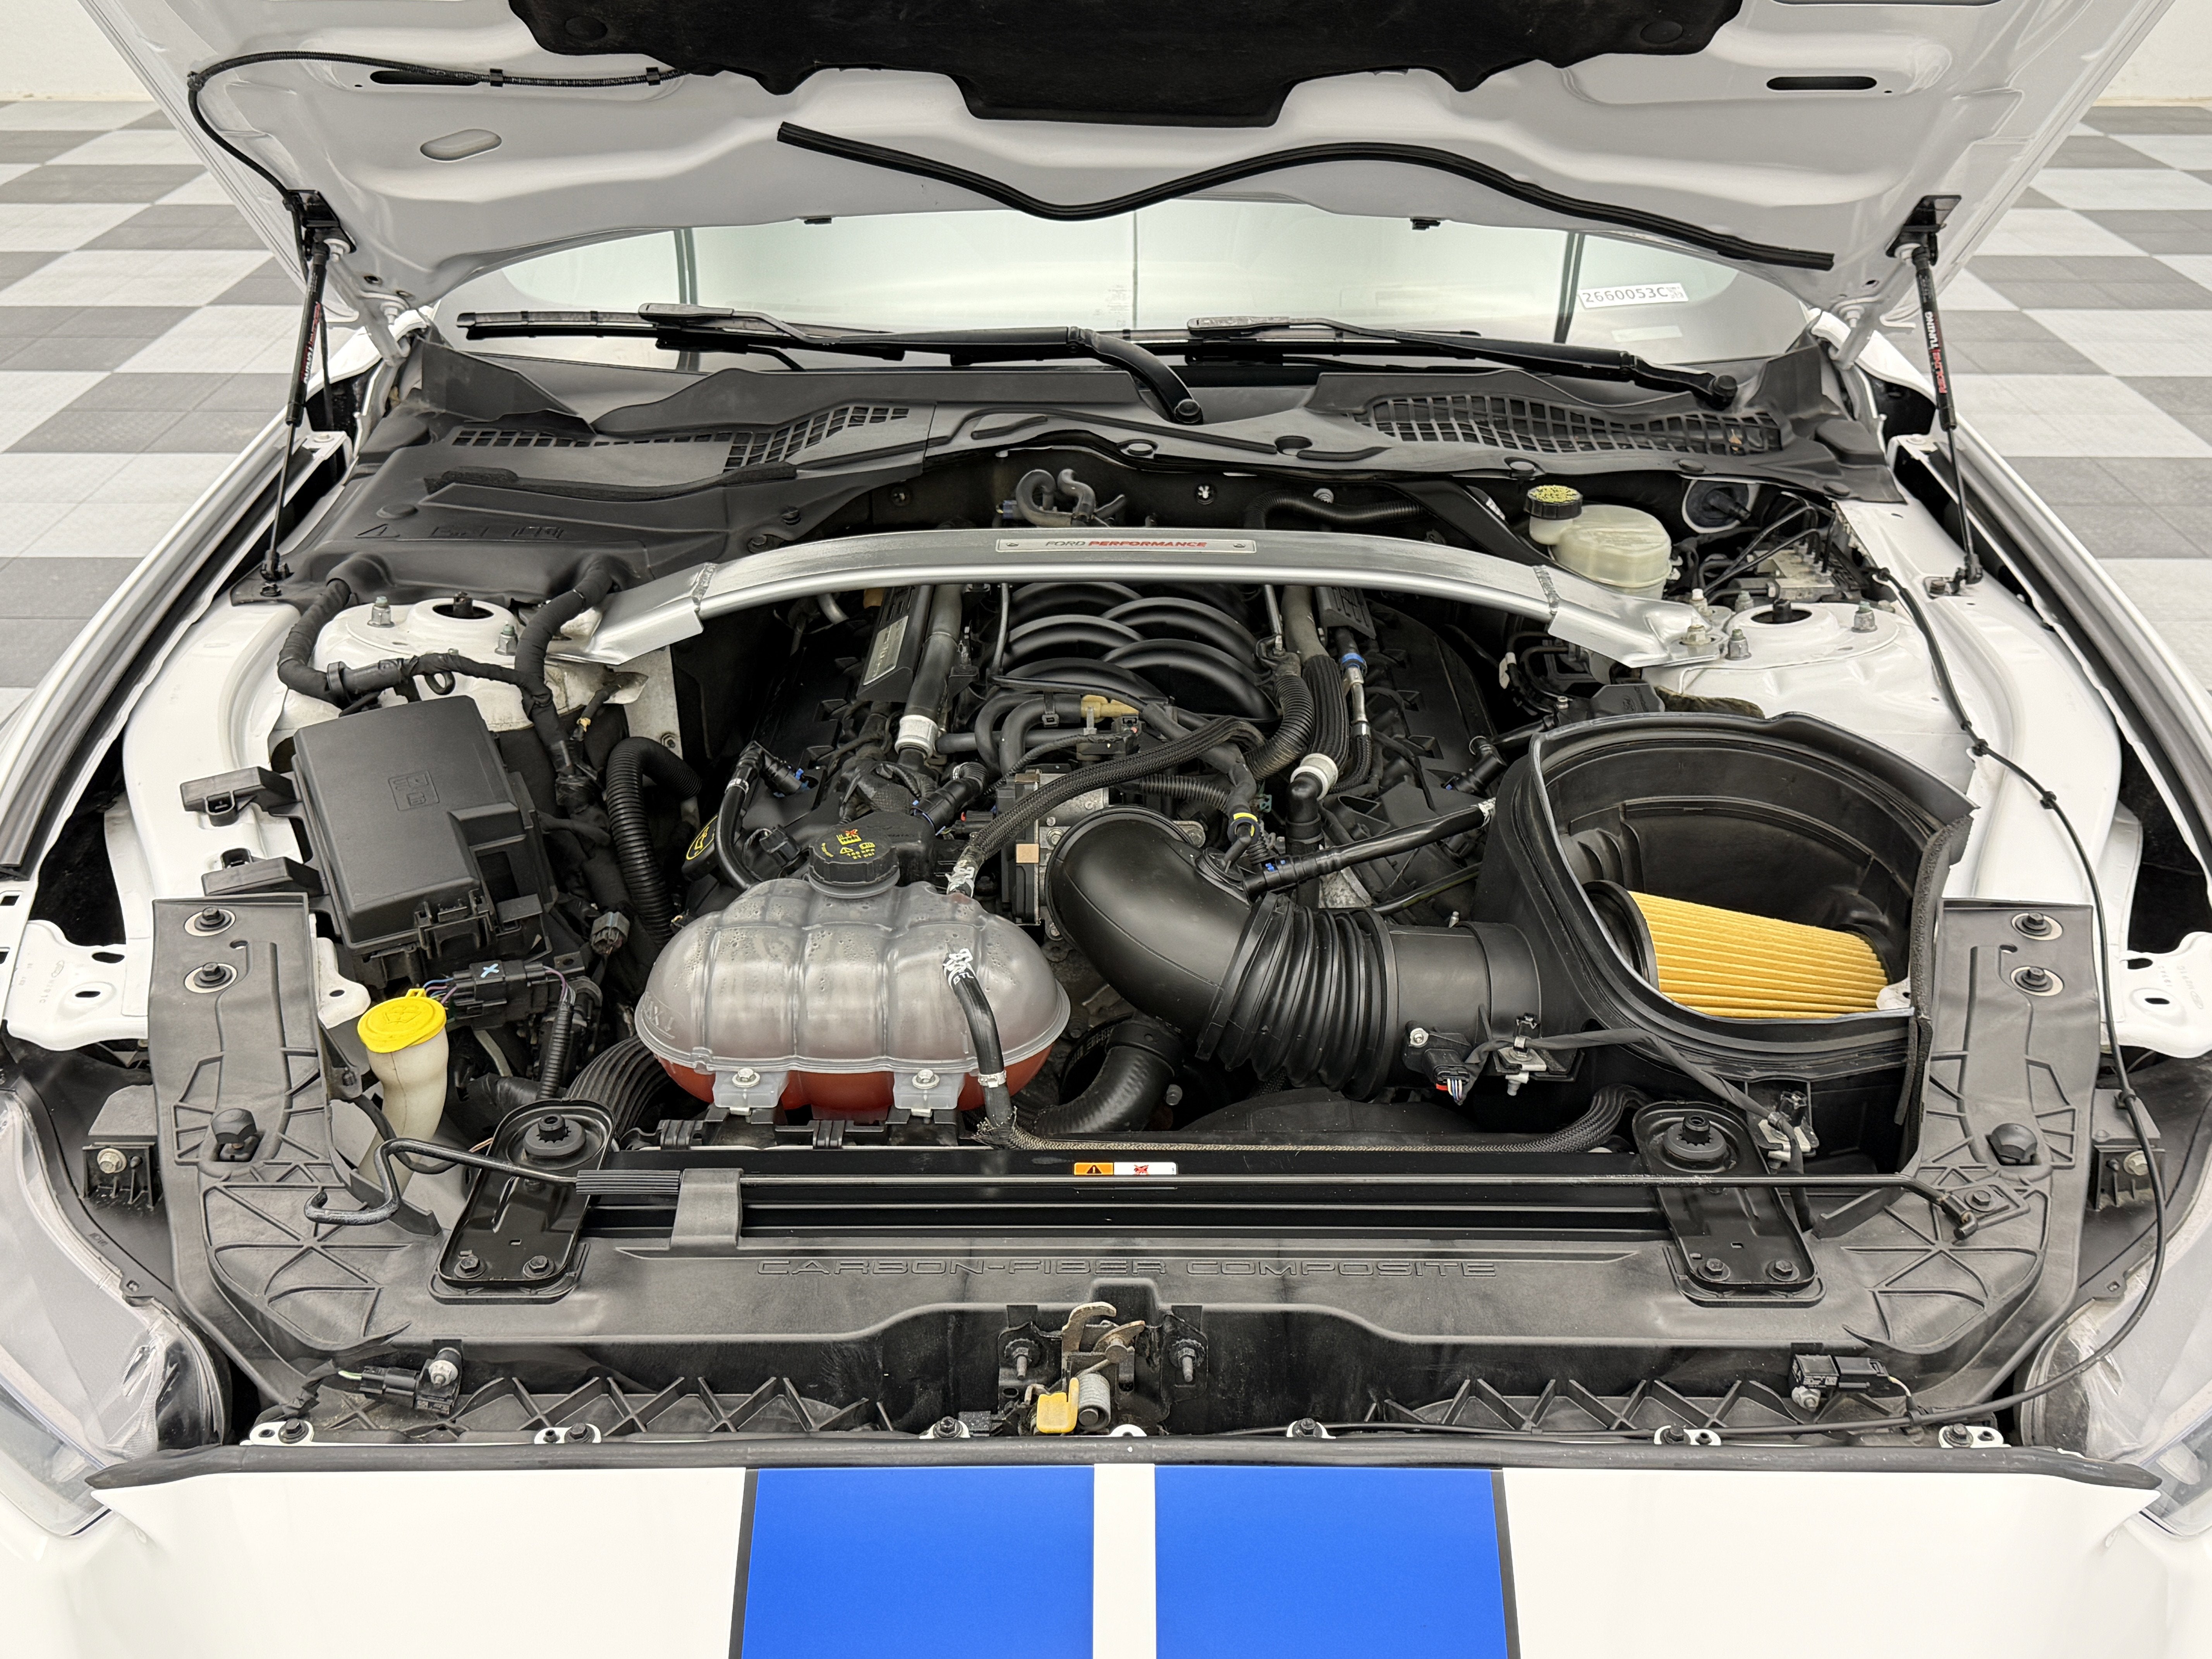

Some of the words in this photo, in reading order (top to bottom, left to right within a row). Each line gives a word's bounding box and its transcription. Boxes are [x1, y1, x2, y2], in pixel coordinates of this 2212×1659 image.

[1582, 287, 1668, 303] 2660053C
[1925, 311, 1939, 349] TUNING
[953, 972, 974, 986] BTL
[758, 1260, 1166, 1276] CARBON-FIBER
[1187, 1260, 1496, 1277] COMPOSITE
